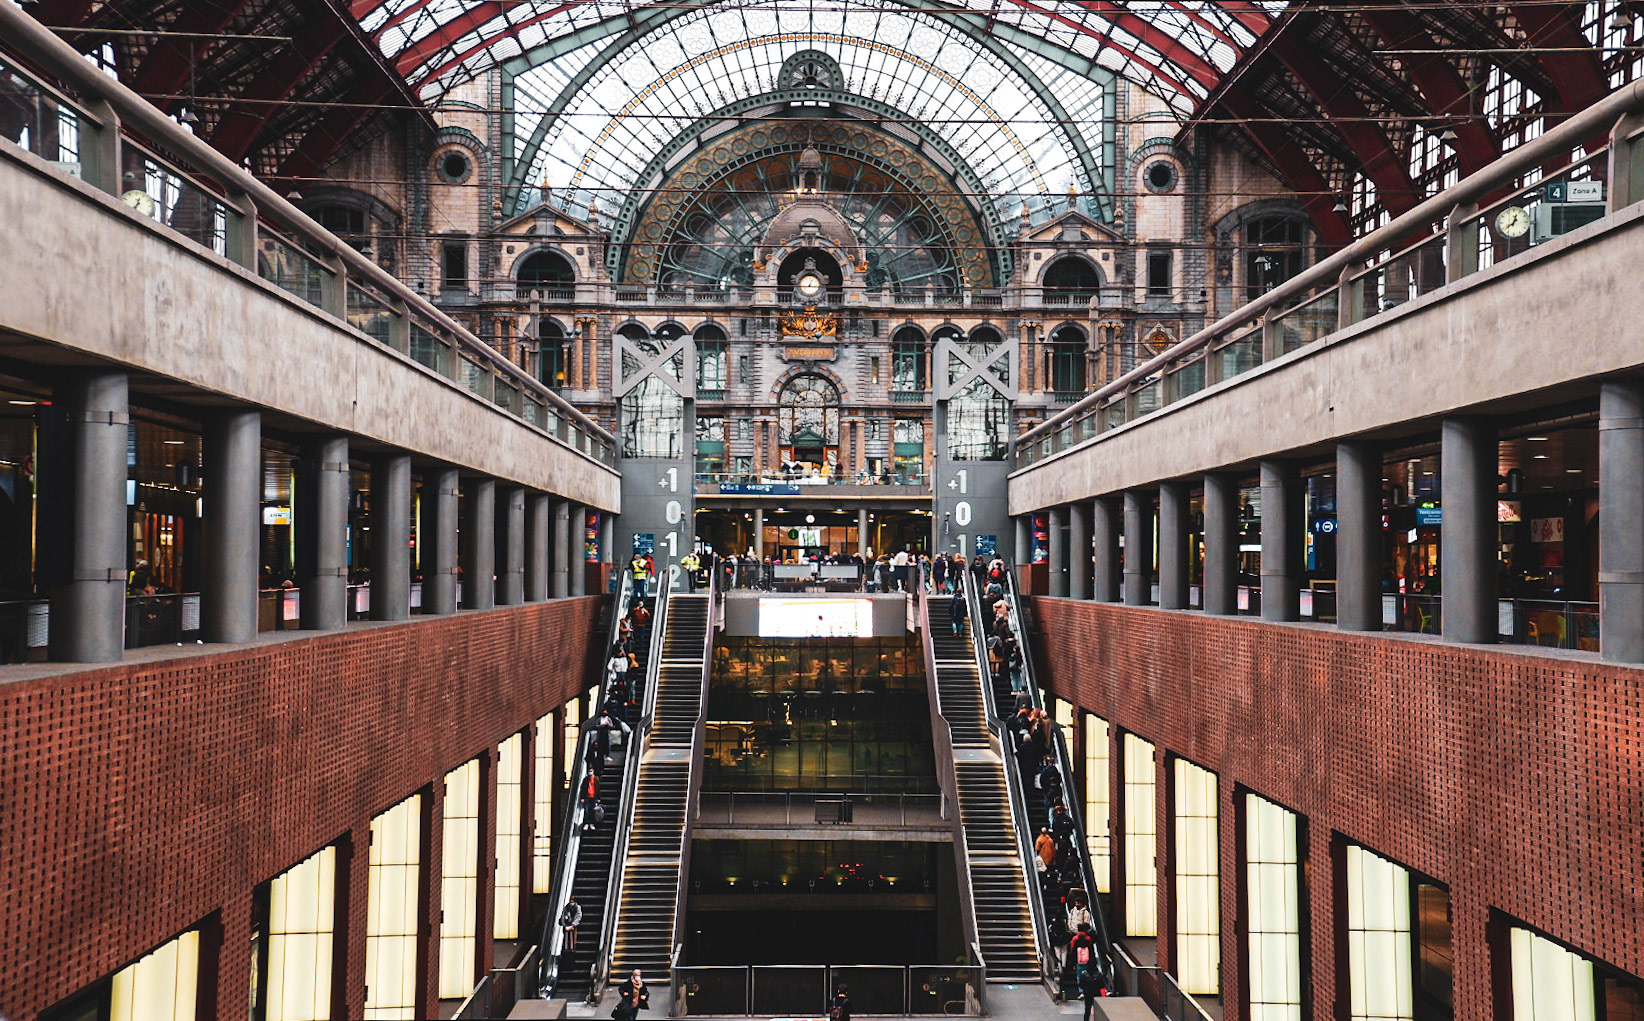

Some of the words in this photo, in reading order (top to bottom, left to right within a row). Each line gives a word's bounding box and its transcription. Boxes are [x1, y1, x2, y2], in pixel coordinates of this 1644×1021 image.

[1552, 187, 1561, 198] 4
[658, 467, 678, 492] +1
[948, 469, 967, 494] +1
[666, 500, 681, 524] 0
[956, 501, 971, 526] 0
[660, 532, 678, 557] -1
[950, 534, 967, 557] -1
